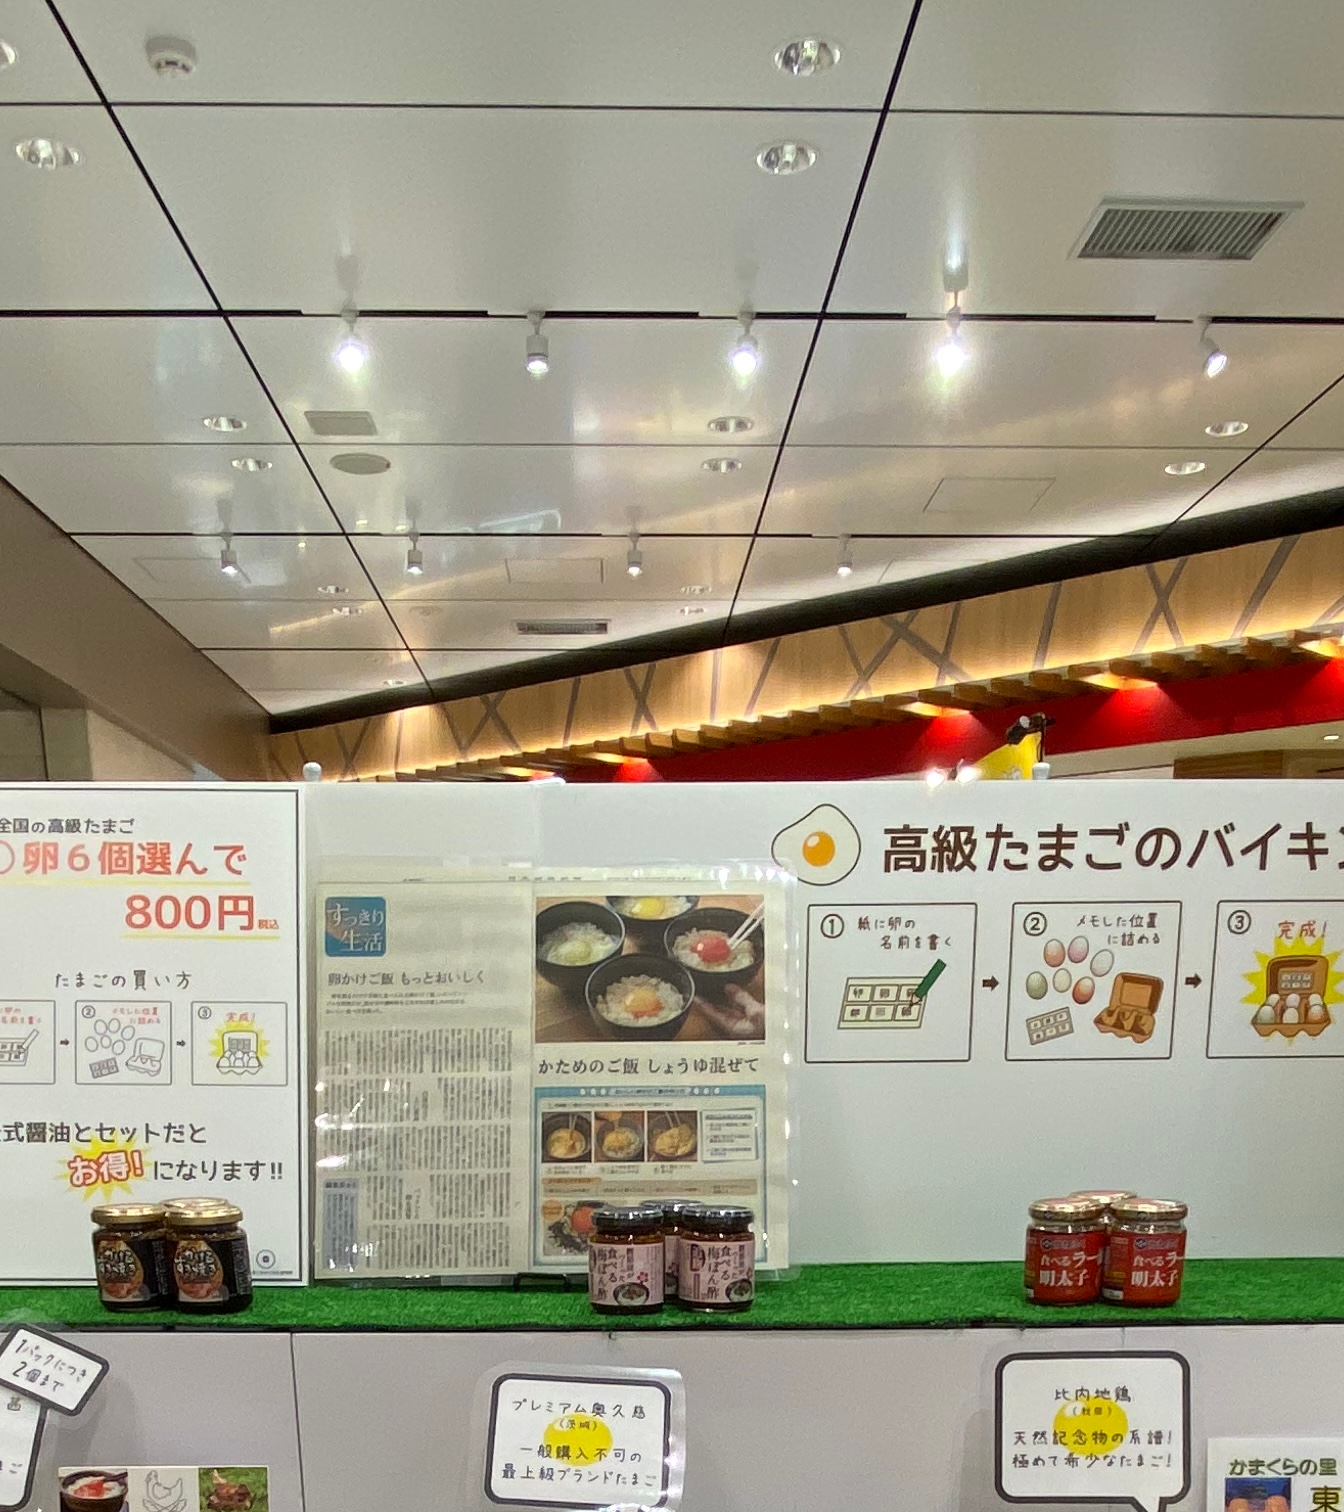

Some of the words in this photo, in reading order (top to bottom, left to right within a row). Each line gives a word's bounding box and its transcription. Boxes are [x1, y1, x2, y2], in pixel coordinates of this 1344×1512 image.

[125, 894, 255, 931] 800円
[326, 903, 385, 927] すっきり
[1076, 912, 1158, 928] メモした位置
[857, 915, 916, 931] 紙に卵の
[339, 928, 384, 952] 生活
[880, 933, 952, 951] 名前を書く
[55, 969, 193, 991] たまごの買い方
[401, 970, 486, 986] もっとおいしく
[538, 1057, 640, 1075] かためのご飯
[648, 1056, 760, 1075] しょうゆ混ぜて
[67, 1150, 145, 1188] お得!
[1039, 1269, 1090, 1287] 明太子
[1131, 1270, 1179, 1288] 明太子
[14, 1338, 88, 1383] 1パックにつき
[11, 1360, 65, 1392] 2個まで
[1054, 1385, 1132, 1403] 比内地鶏
[511, 1398, 646, 1419] プレミアム奥久慈
[1012, 1429, 1173, 1446] 天然記念物の系譜!
[519, 1443, 642, 1463] 一般購入不可の
[1012, 1451, 1173, 1469] 極めて希少なたまご!
[501, 1463, 657, 1487] 最上級ブランドたまご
[1229, 1457, 1338, 1477] かまくらの里
